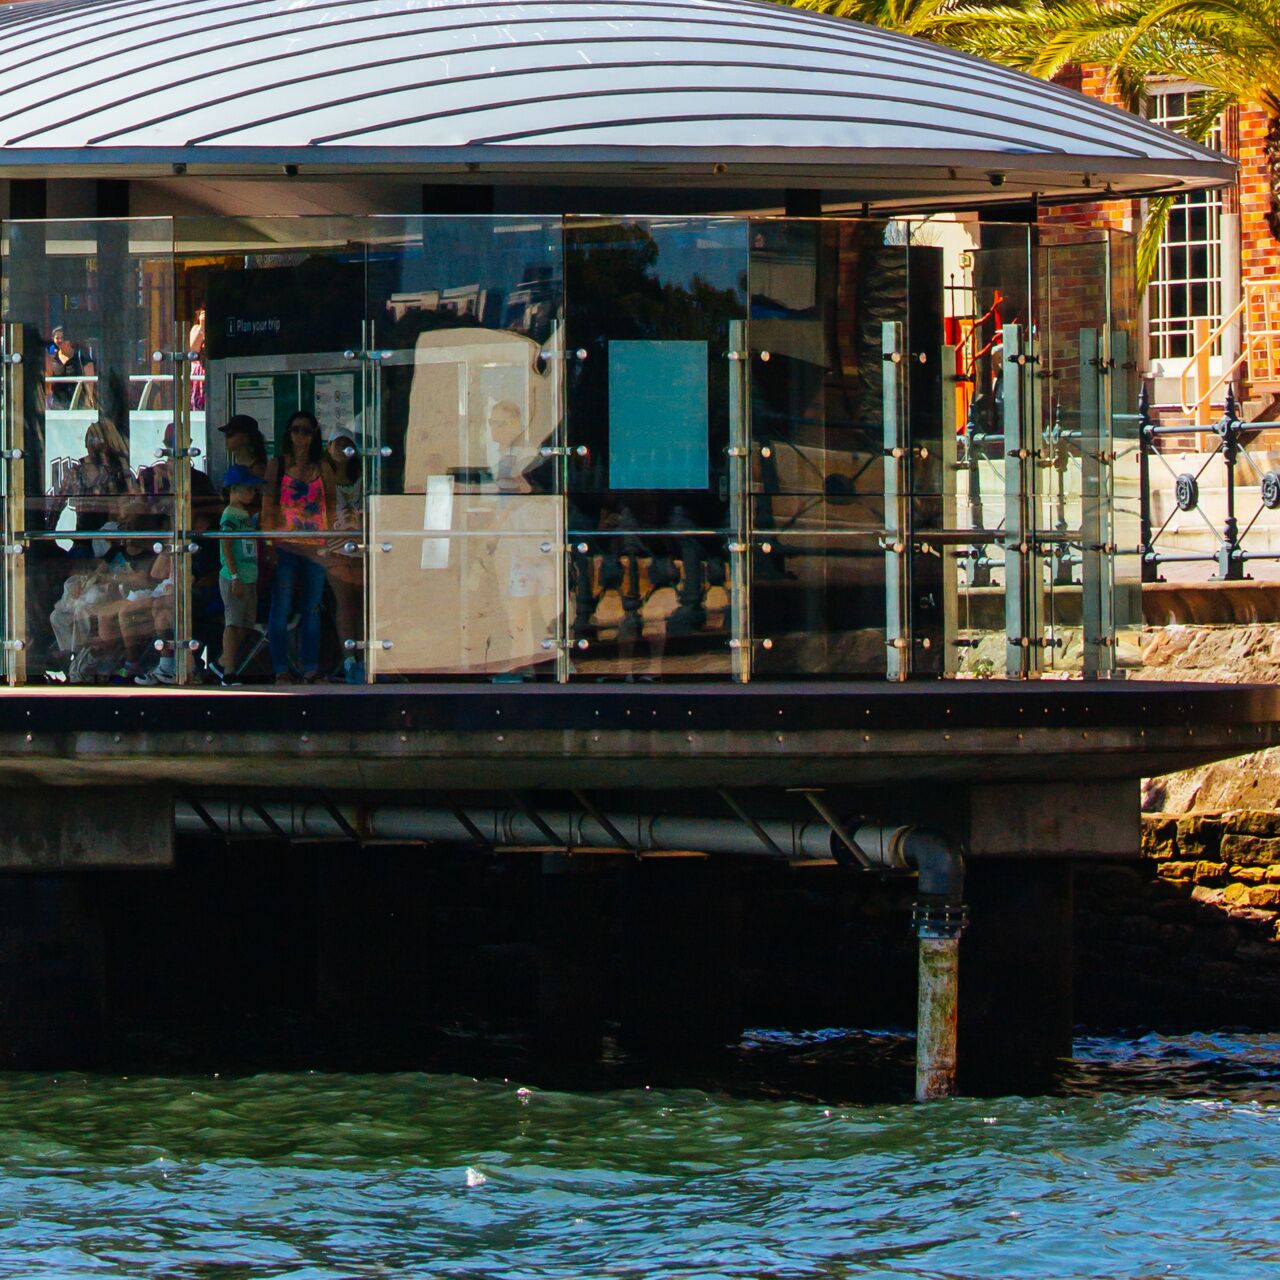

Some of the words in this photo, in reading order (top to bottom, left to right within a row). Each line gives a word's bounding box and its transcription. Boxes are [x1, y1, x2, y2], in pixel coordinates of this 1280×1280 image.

[237, 319, 251, 332] Plan
[253, 320, 267, 335] your
[268, 318, 281, 336] trip
